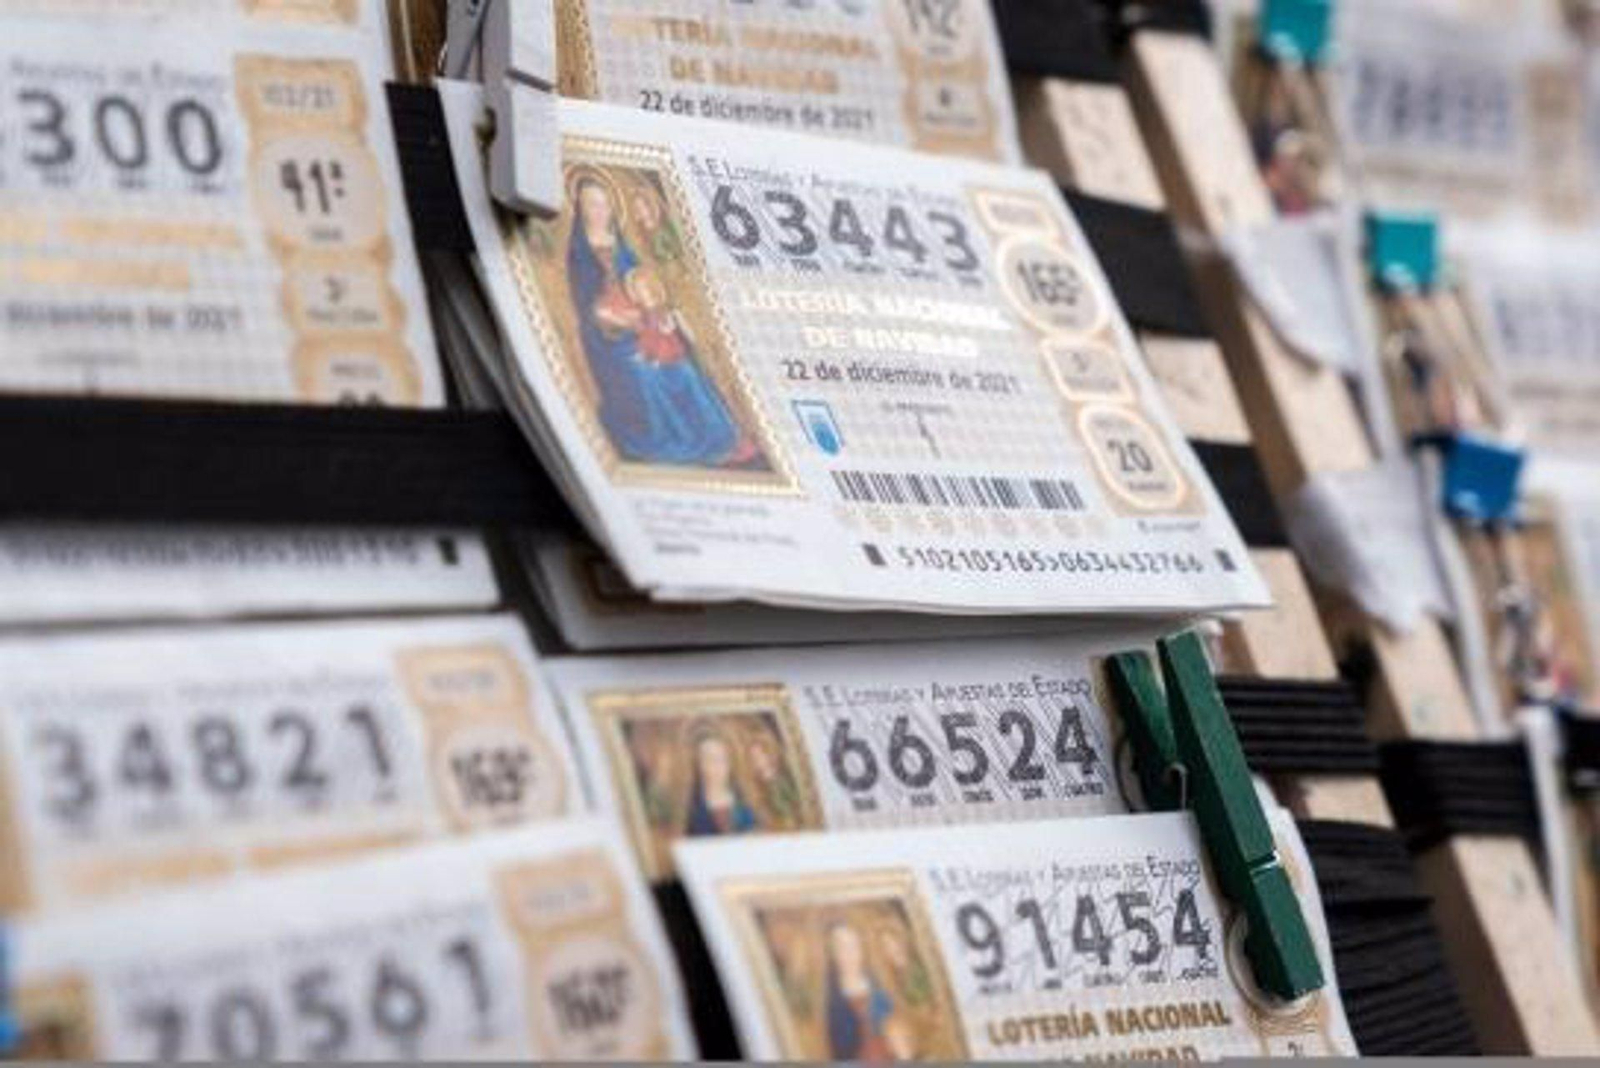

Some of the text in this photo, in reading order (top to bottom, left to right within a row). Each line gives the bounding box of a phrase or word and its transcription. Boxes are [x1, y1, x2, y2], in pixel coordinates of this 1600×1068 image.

[639, 90, 875, 130] 22 de diciembre de 2021
[710, 183, 979, 271] 63443
[801, 325, 846, 349] DE
[780, 359, 1023, 395] 22 de diciembre de 2021
[1107, 439, 1154, 473] 20
[1033, 673, 1093, 698] ESTADO
[40, 704, 392, 812] 34821
[830, 705, 1100, 793] 66524
[1146, 856, 1201, 877] ESTADO
[955, 887, 1212, 979] 91454
[986, 1001, 1231, 1046] LOTERÍA NACIONAL
